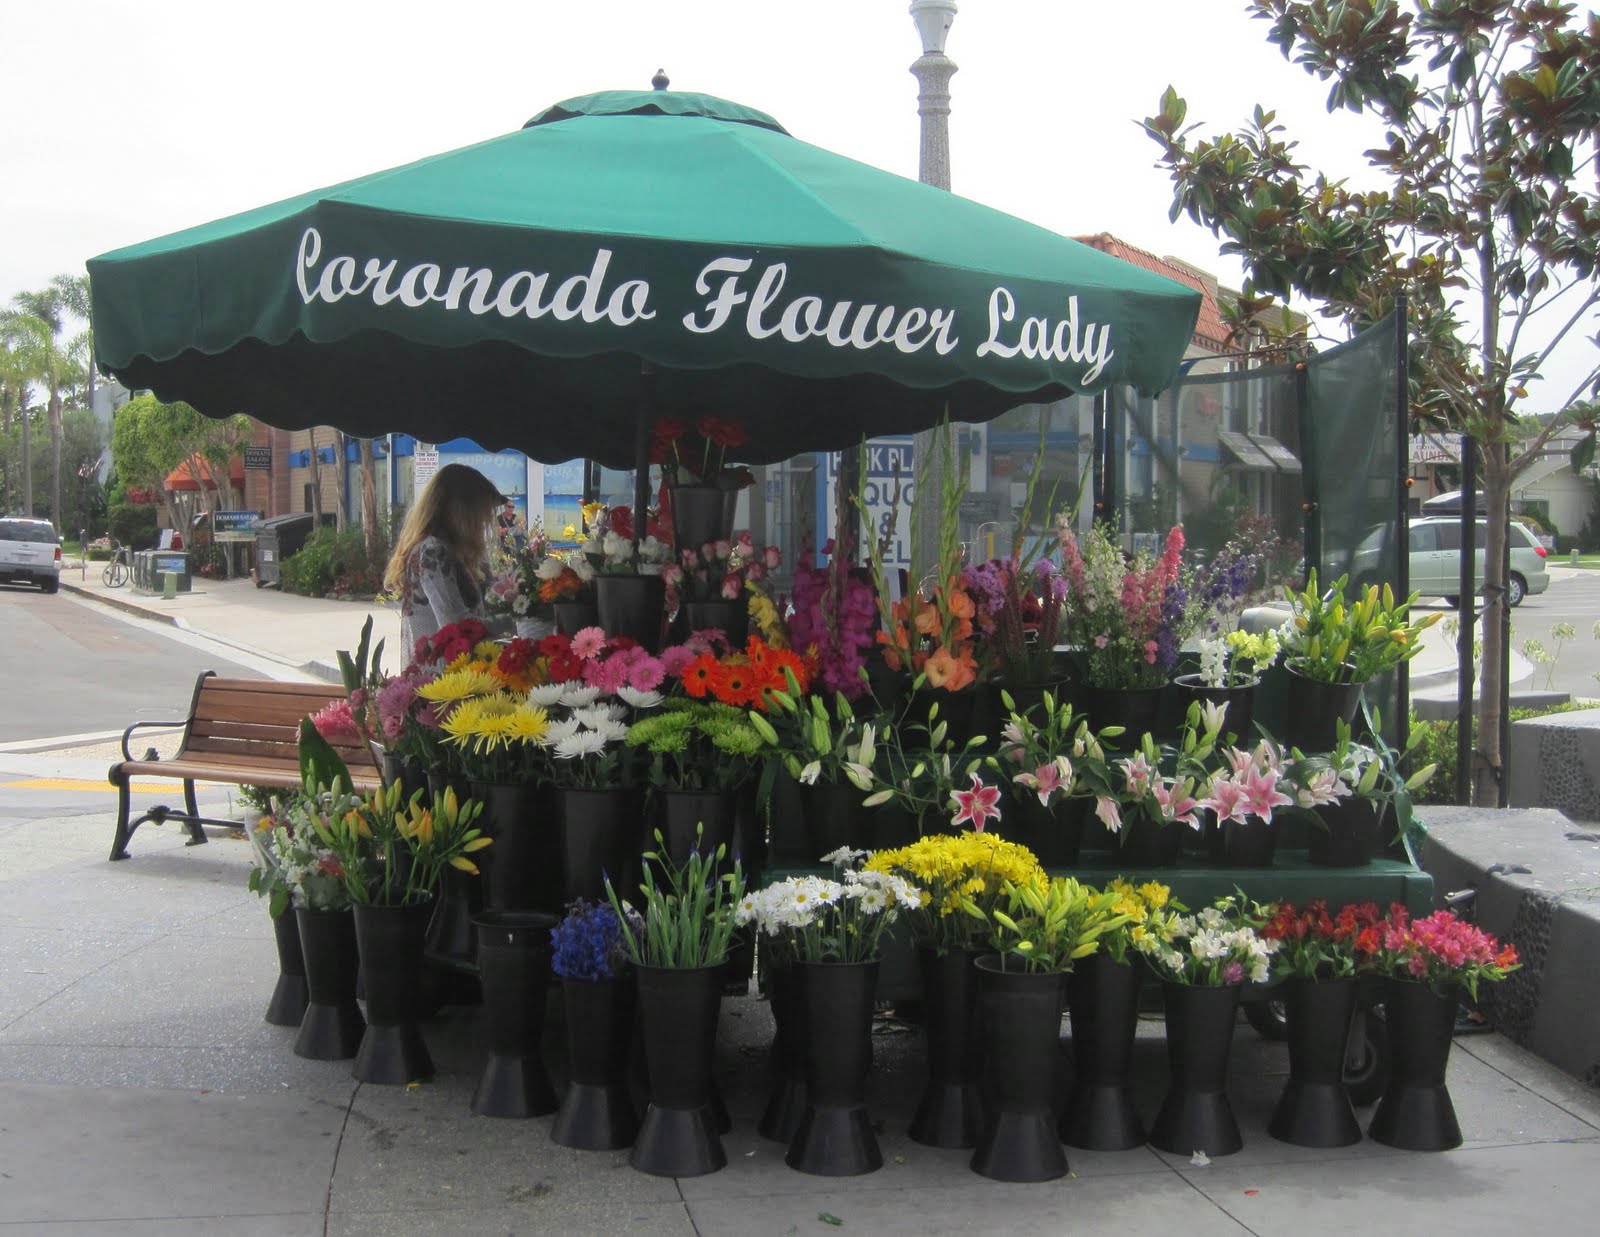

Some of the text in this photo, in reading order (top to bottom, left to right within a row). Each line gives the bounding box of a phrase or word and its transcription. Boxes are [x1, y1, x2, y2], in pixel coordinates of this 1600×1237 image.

[296, 227, 1115, 386] Coronado Flower Lady
